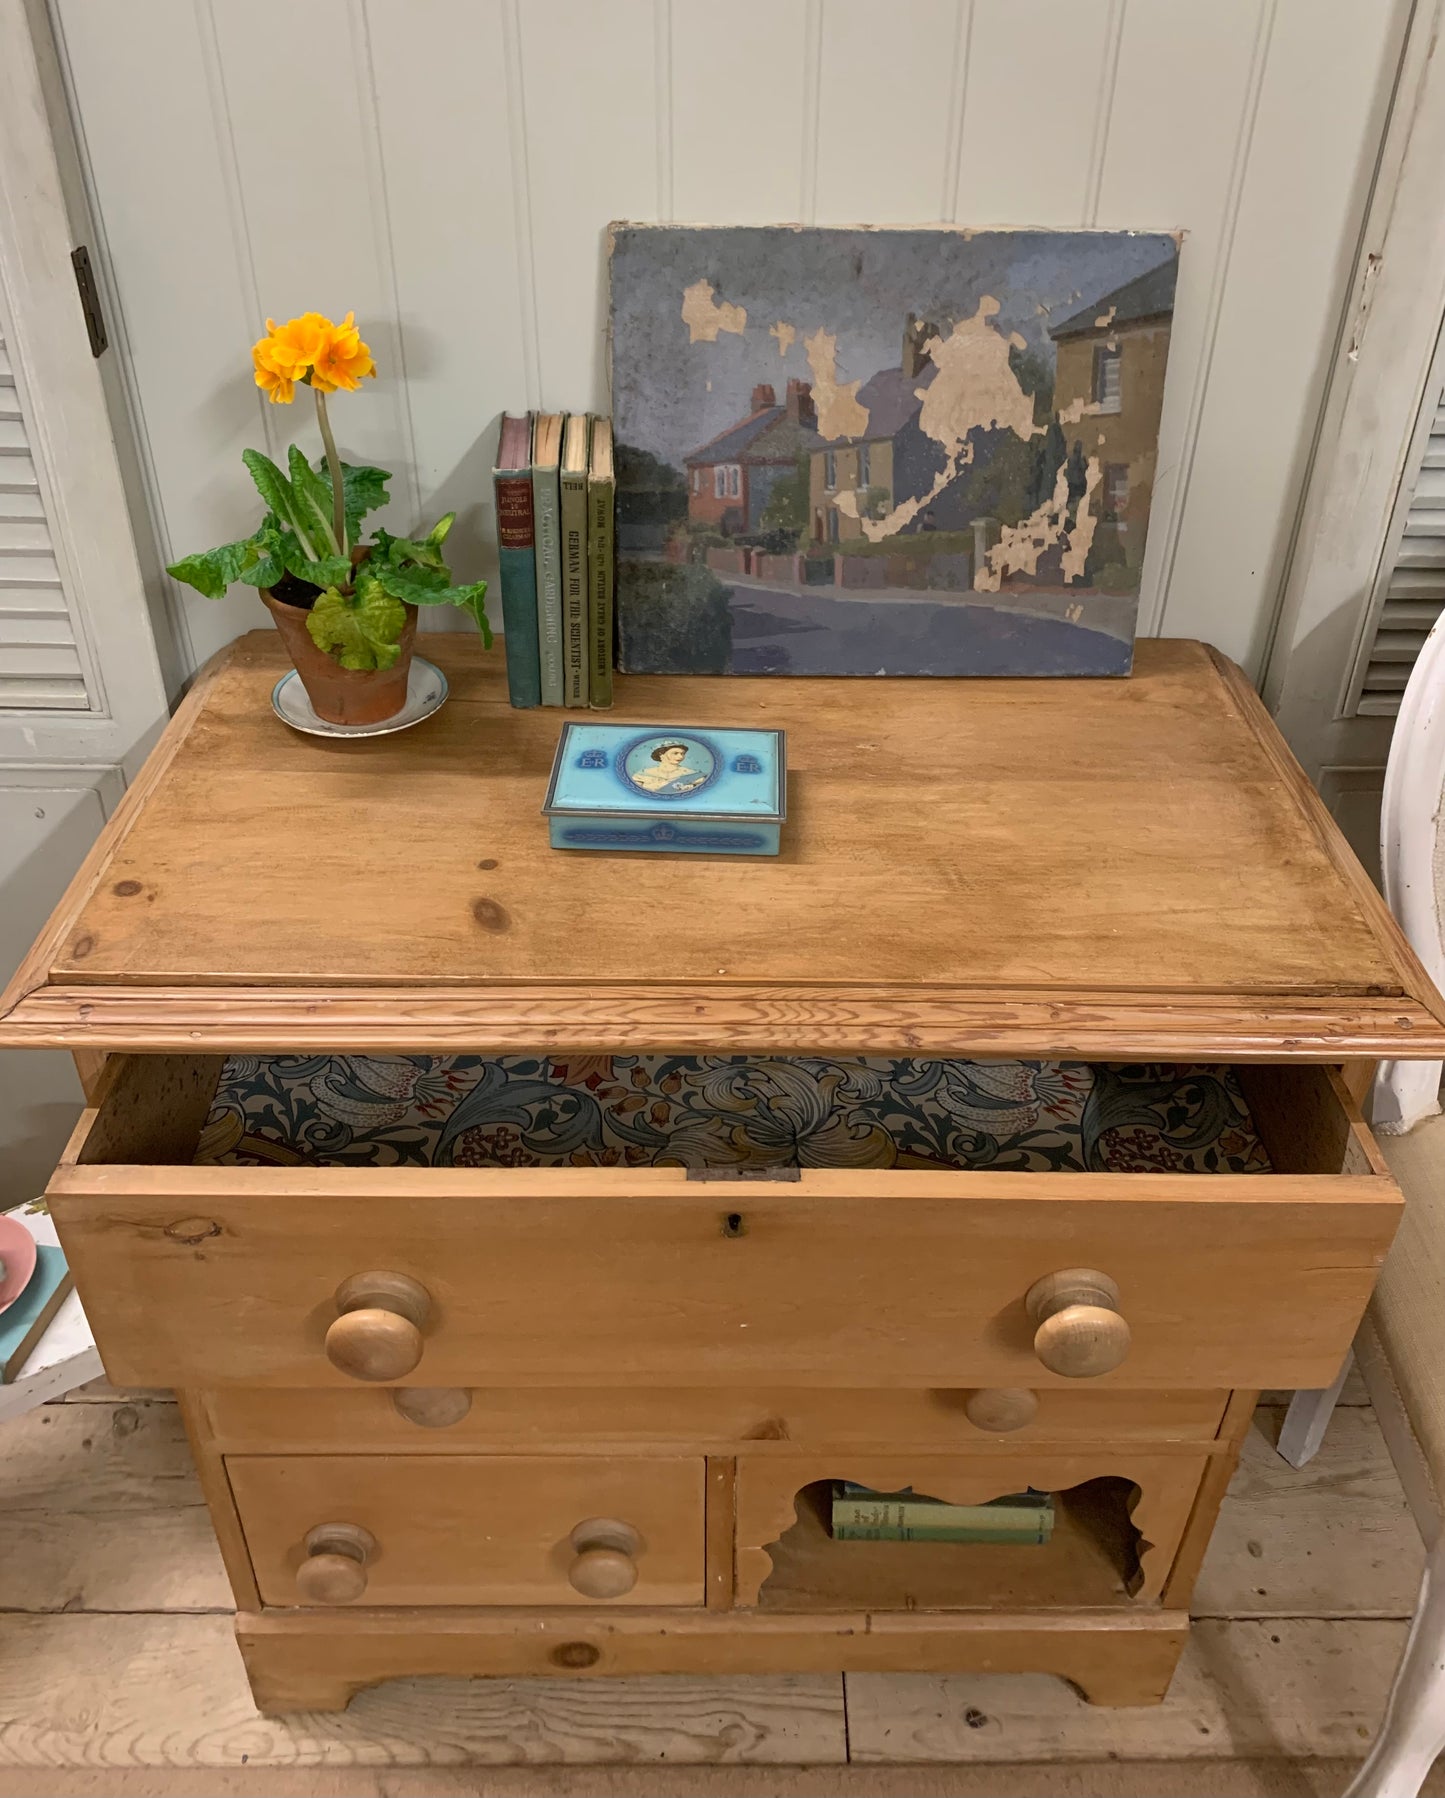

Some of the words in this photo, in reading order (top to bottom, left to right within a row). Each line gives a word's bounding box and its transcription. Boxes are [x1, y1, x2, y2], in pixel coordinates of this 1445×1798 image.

[597, 498, 606, 529] MOWAT
[568, 531, 580, 573] GERMAN
[569, 578, 580, 596] FOR
[597, 570, 606, 600] BRITAIN
[569, 600, 581, 618] THE
[597, 602, 606, 625] GREAT
[570, 622, 581, 669] SCIENTIST
[597, 627, 606, 637] OF
[597, 638, 606, 670] HISTORY
